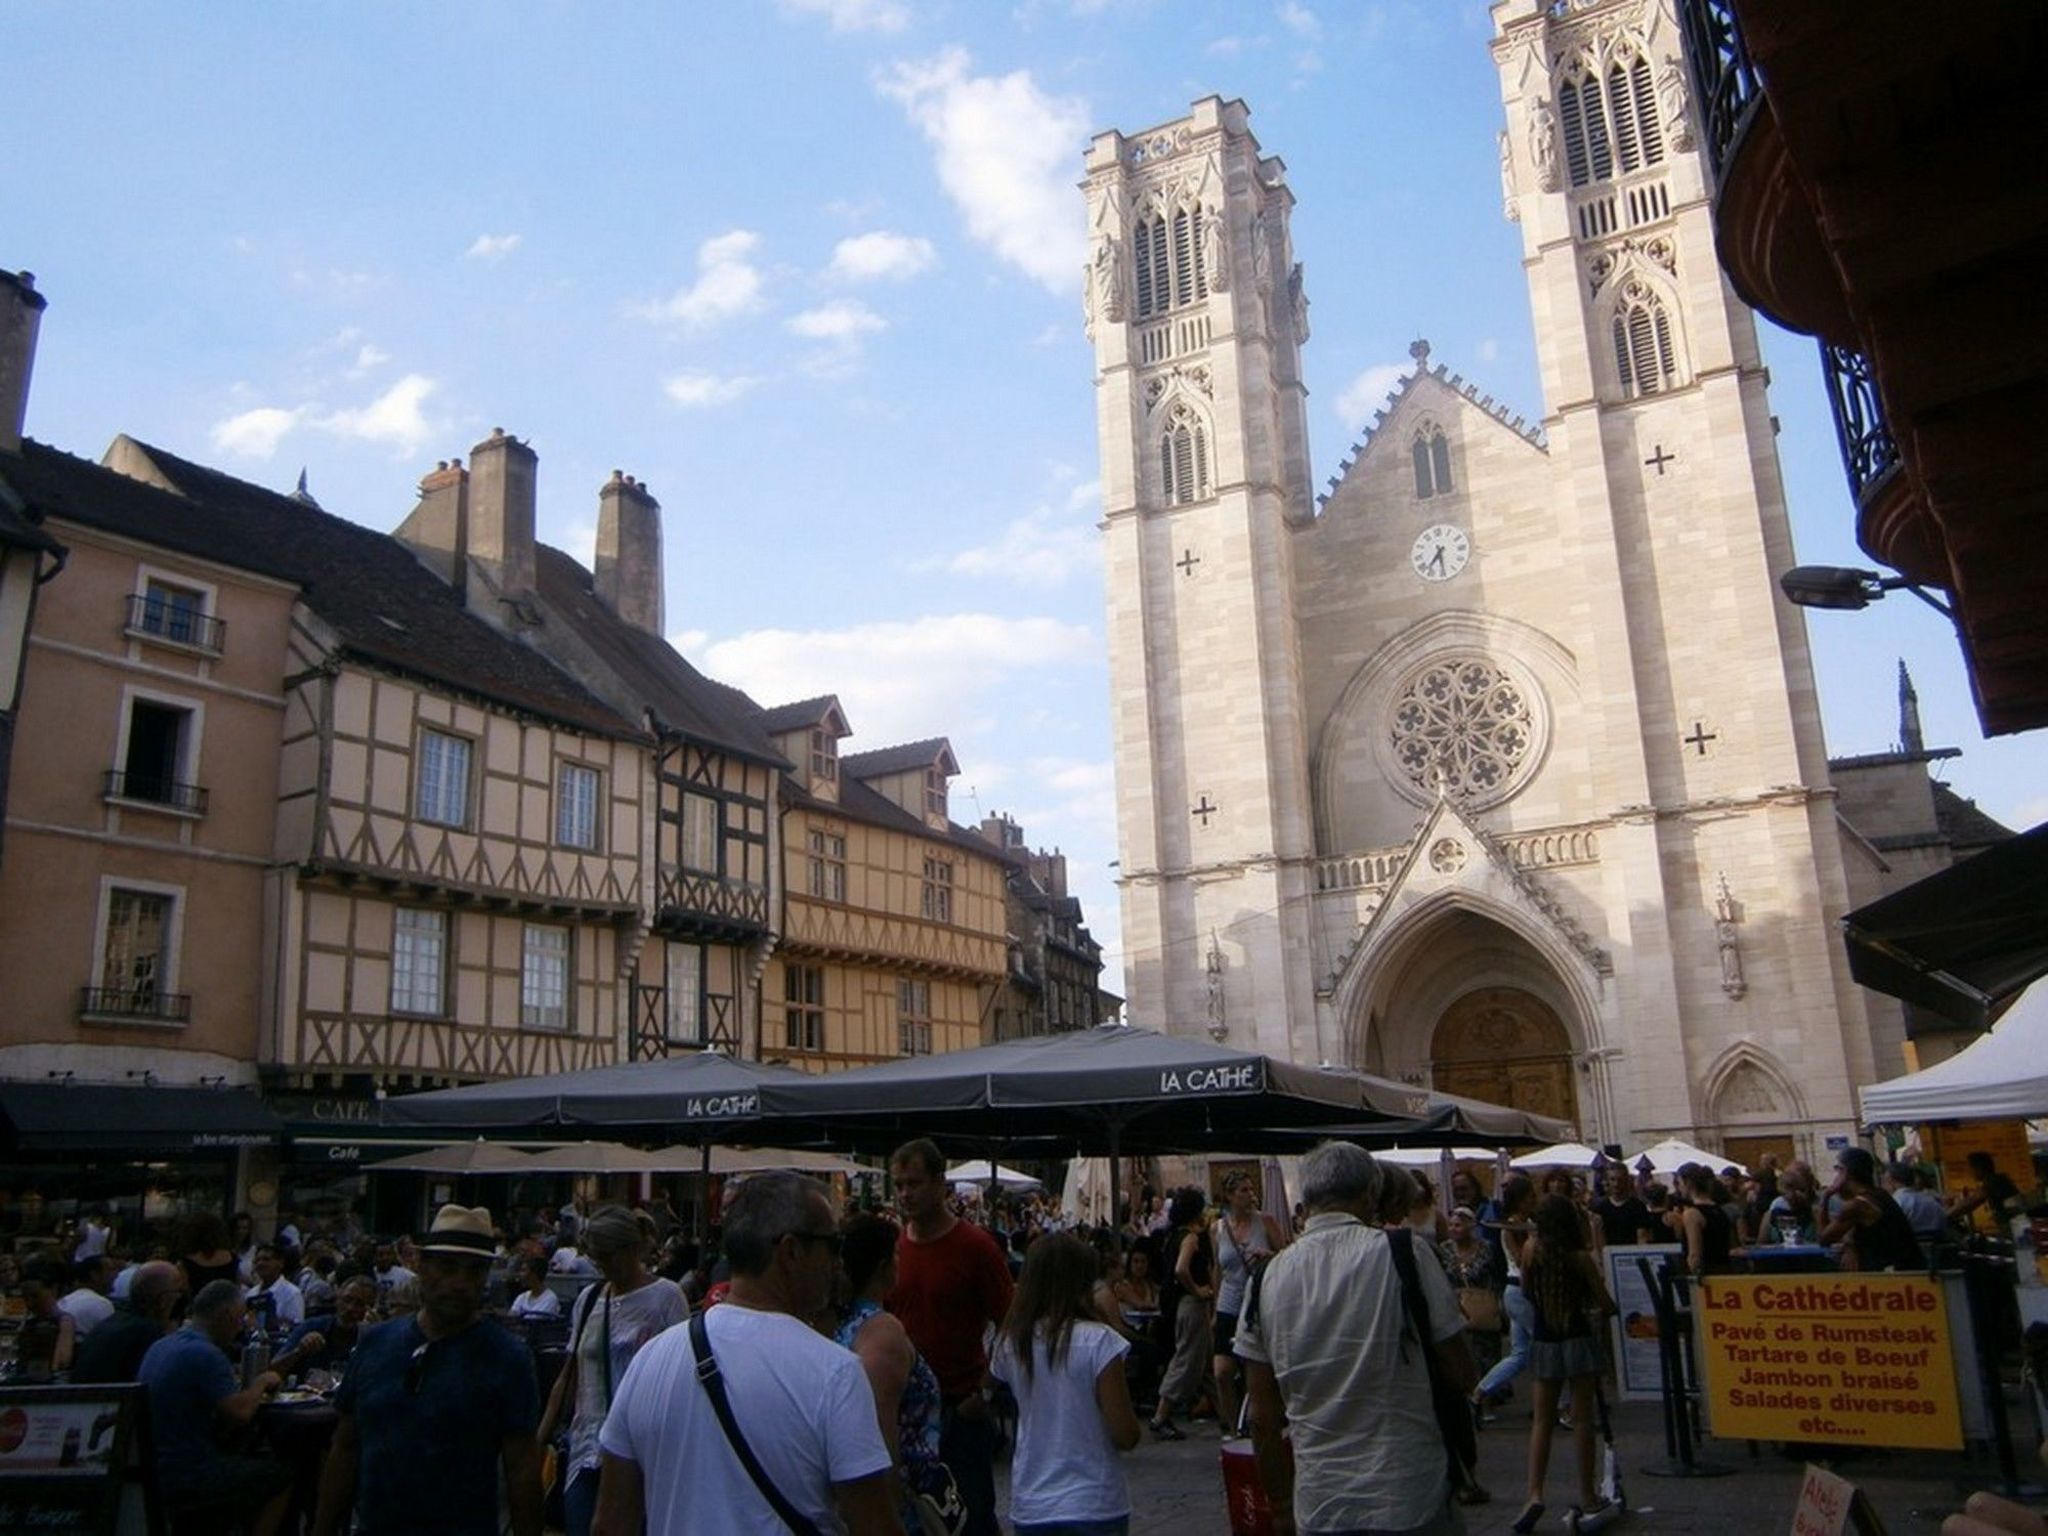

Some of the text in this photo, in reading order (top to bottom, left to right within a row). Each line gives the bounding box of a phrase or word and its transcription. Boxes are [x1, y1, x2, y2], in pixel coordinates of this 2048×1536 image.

[1160, 1071, 1182, 1093] LA
[687, 1098, 704, 1116] LA
[328, 1146, 361, 1160] Café
[1704, 1283, 1937, 1312] La Cathédrale
[1711, 1321, 1937, 1344] Pavé de Rumsteak
[1724, 1344, 1929, 1367] Tartare de Boeuf
[1739, 1368, 1919, 1390] Jambon braisé
[1729, 1388, 1937, 1415] Salades diverses
